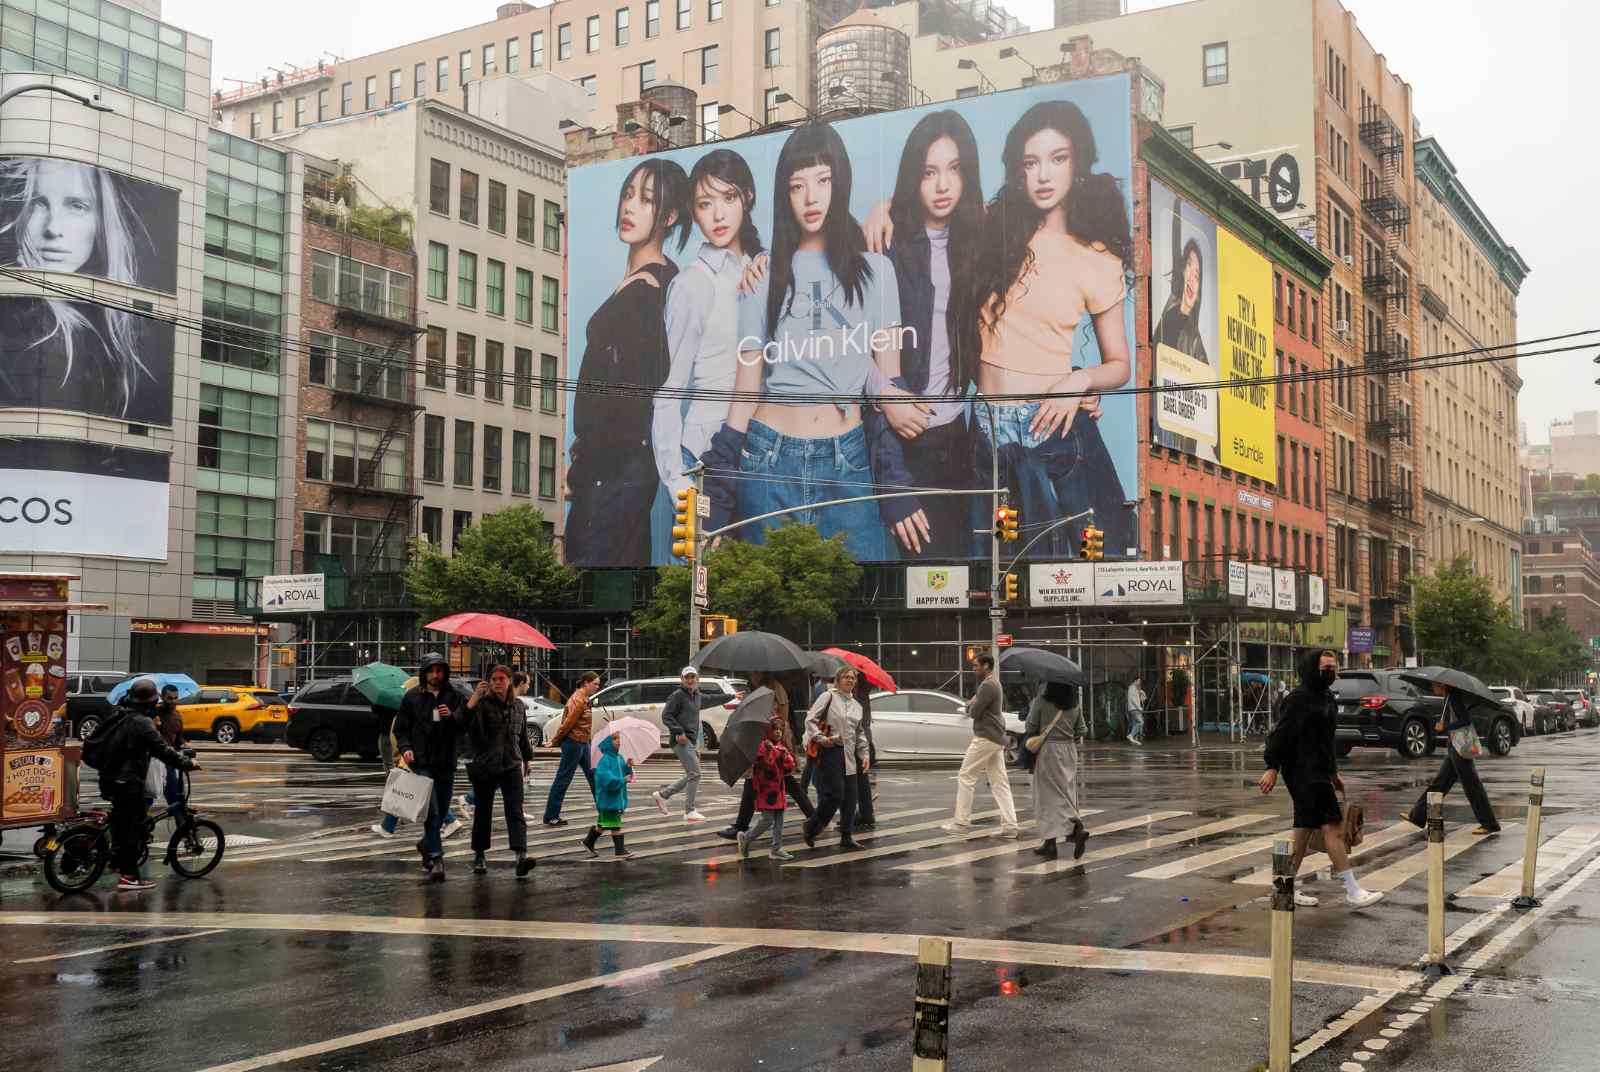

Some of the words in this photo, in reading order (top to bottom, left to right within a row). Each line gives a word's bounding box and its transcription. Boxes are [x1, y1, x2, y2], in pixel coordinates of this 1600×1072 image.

[1237, 294, 1250, 323] TRY
[1252, 303, 1257, 328] A
[737, 329, 834, 366] Calvin
[842, 321, 918, 355] Klein
[1227, 314, 1243, 345] NEW
[1243, 323, 1257, 354] WAY
[1259, 332, 1267, 360] TO
[1232, 345, 1250, 377] MAKE
[1252, 353, 1263, 385] THE
[1229, 370, 1248, 402] FIRST
[1239, 438, 1265, 465] Bumble
[0, 496, 73, 526] COS
[284, 589, 321, 601] ROYAL
[916, 596, 939, 605] HAPPY
[940, 596, 960, 605] PAWS
[1127, 579, 1177, 592] ROYAL
[13, 768, 32, 781] HOT
[33, 767, 57, 779] DOGS
